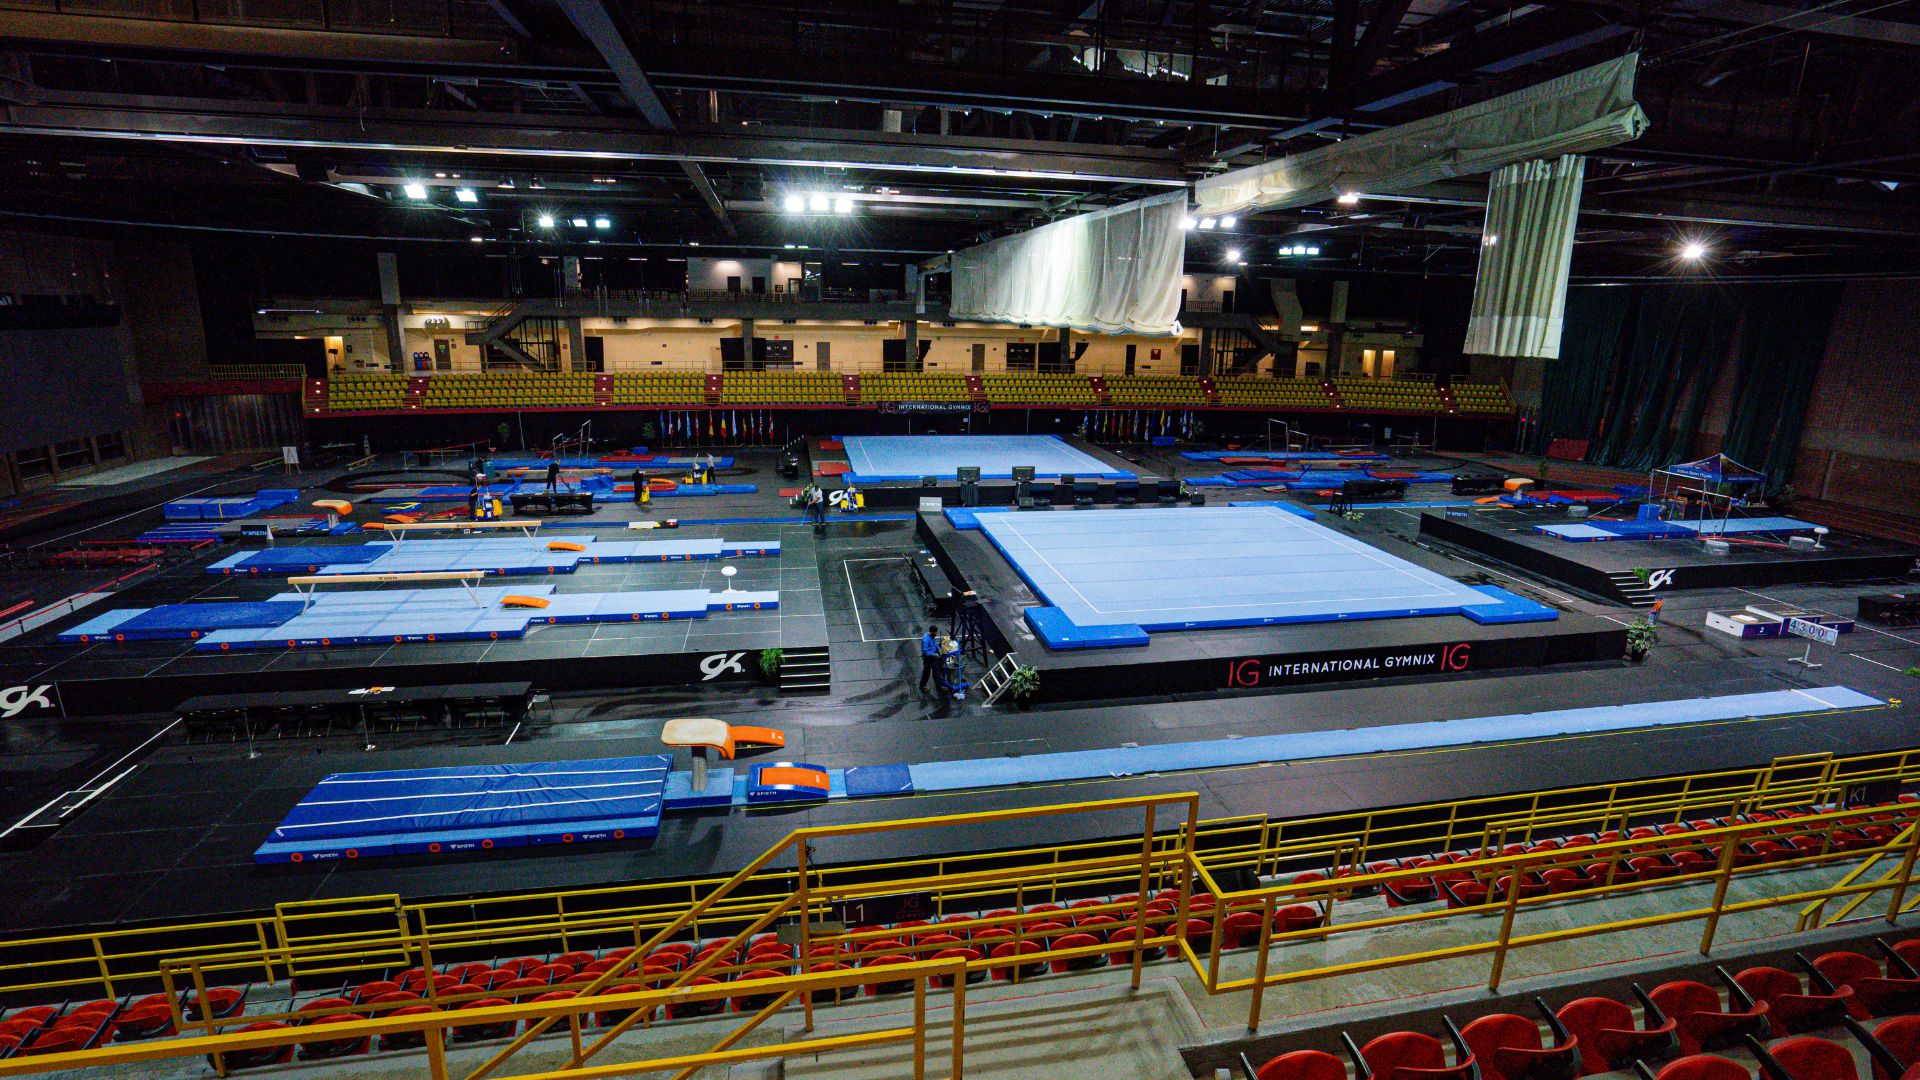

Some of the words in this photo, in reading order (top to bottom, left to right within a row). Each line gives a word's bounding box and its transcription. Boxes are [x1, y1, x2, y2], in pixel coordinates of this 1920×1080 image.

[700, 652, 747, 681] GK
[1228, 659, 1262, 688] IG
[1268, 658, 1380, 677] INTERNATIONAL
[1384, 654, 1436, 667] GYMNIX
[1441, 643, 1471, 672] IG
[1850, 786, 1866, 803] K1
[843, 903, 864, 924] L1
